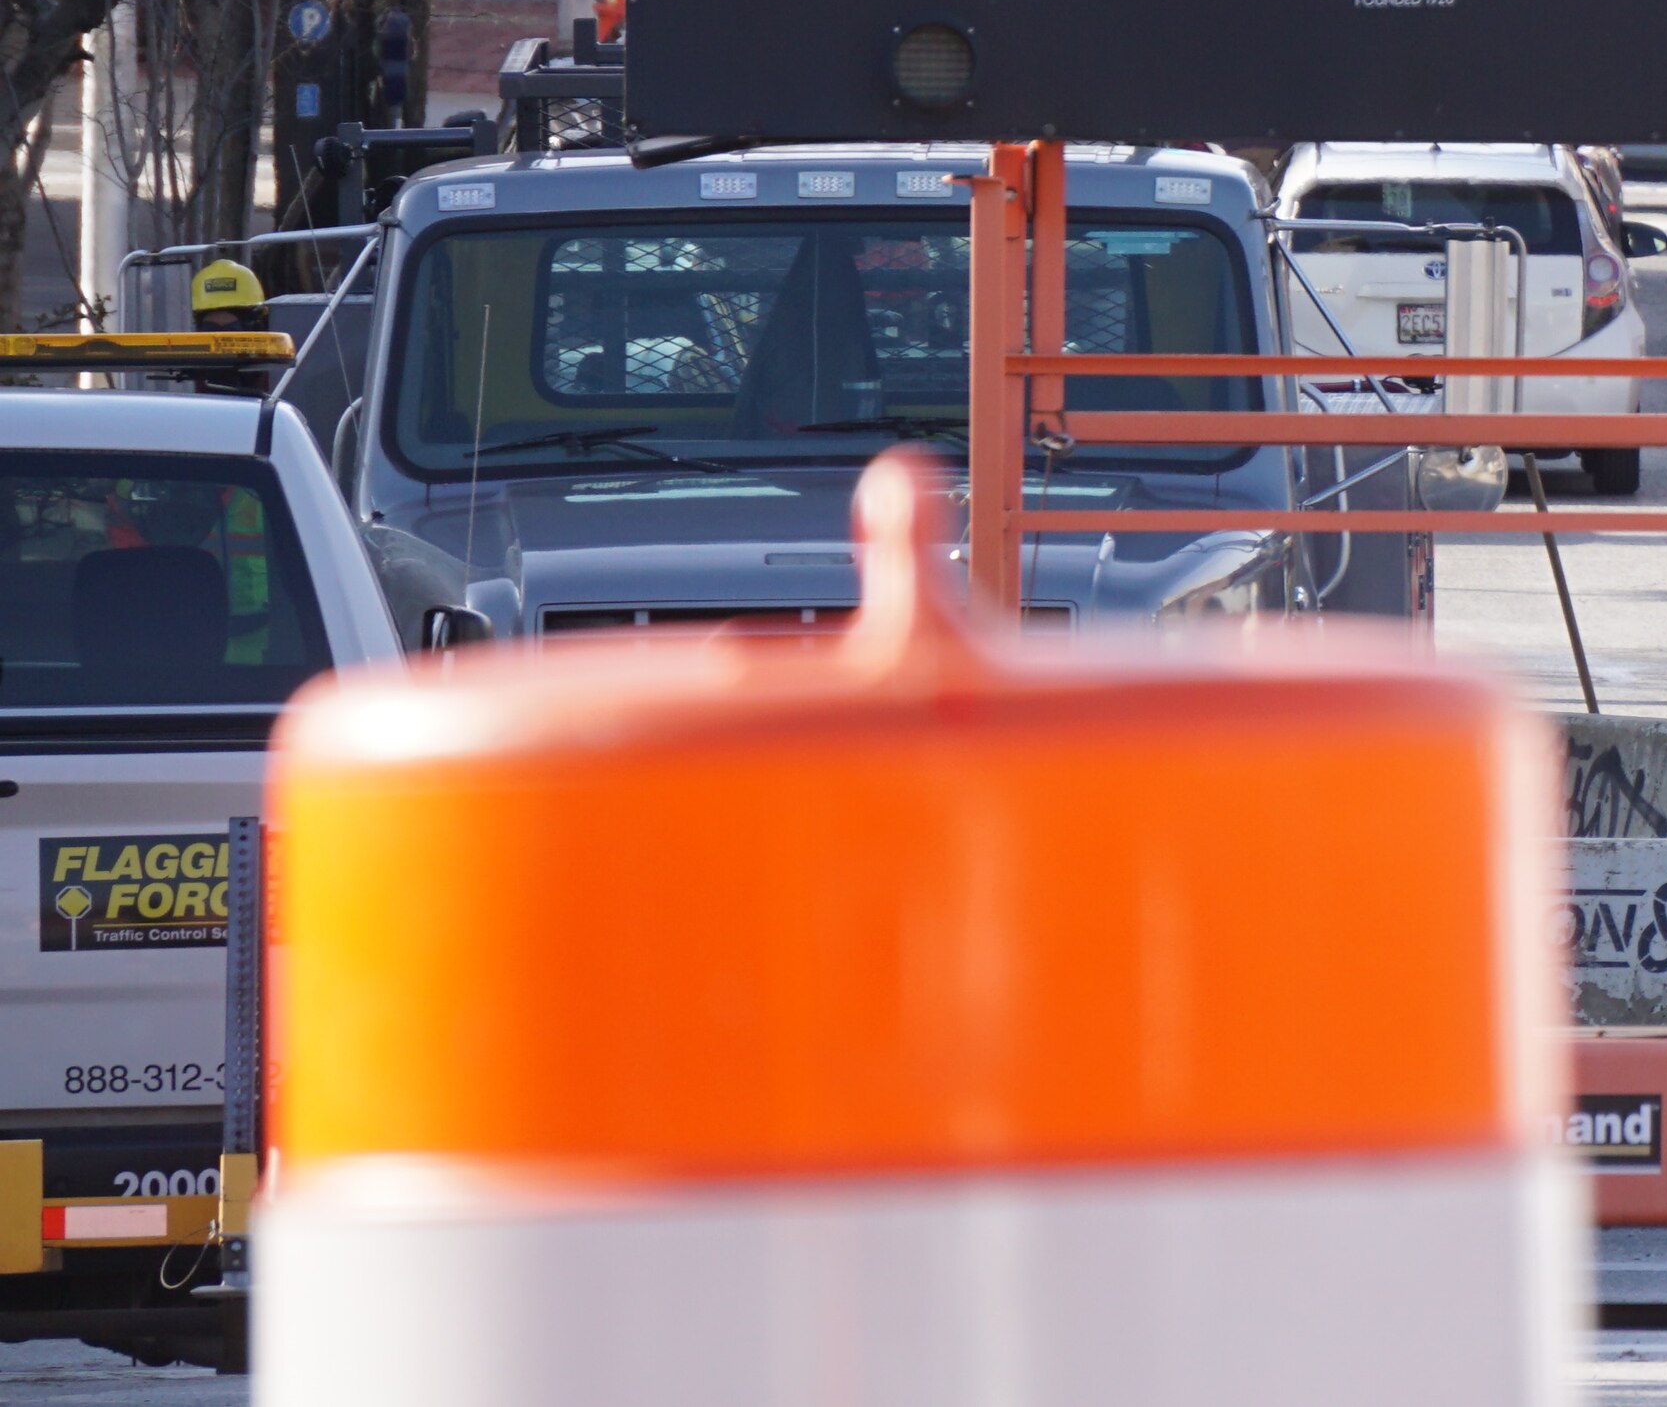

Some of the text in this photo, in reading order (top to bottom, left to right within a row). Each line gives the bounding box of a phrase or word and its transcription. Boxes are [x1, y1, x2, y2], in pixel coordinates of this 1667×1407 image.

[94, 929, 145, 942] Traffic
[149, 927, 207, 941] Control
[112, 1167, 220, 1197] 2000
